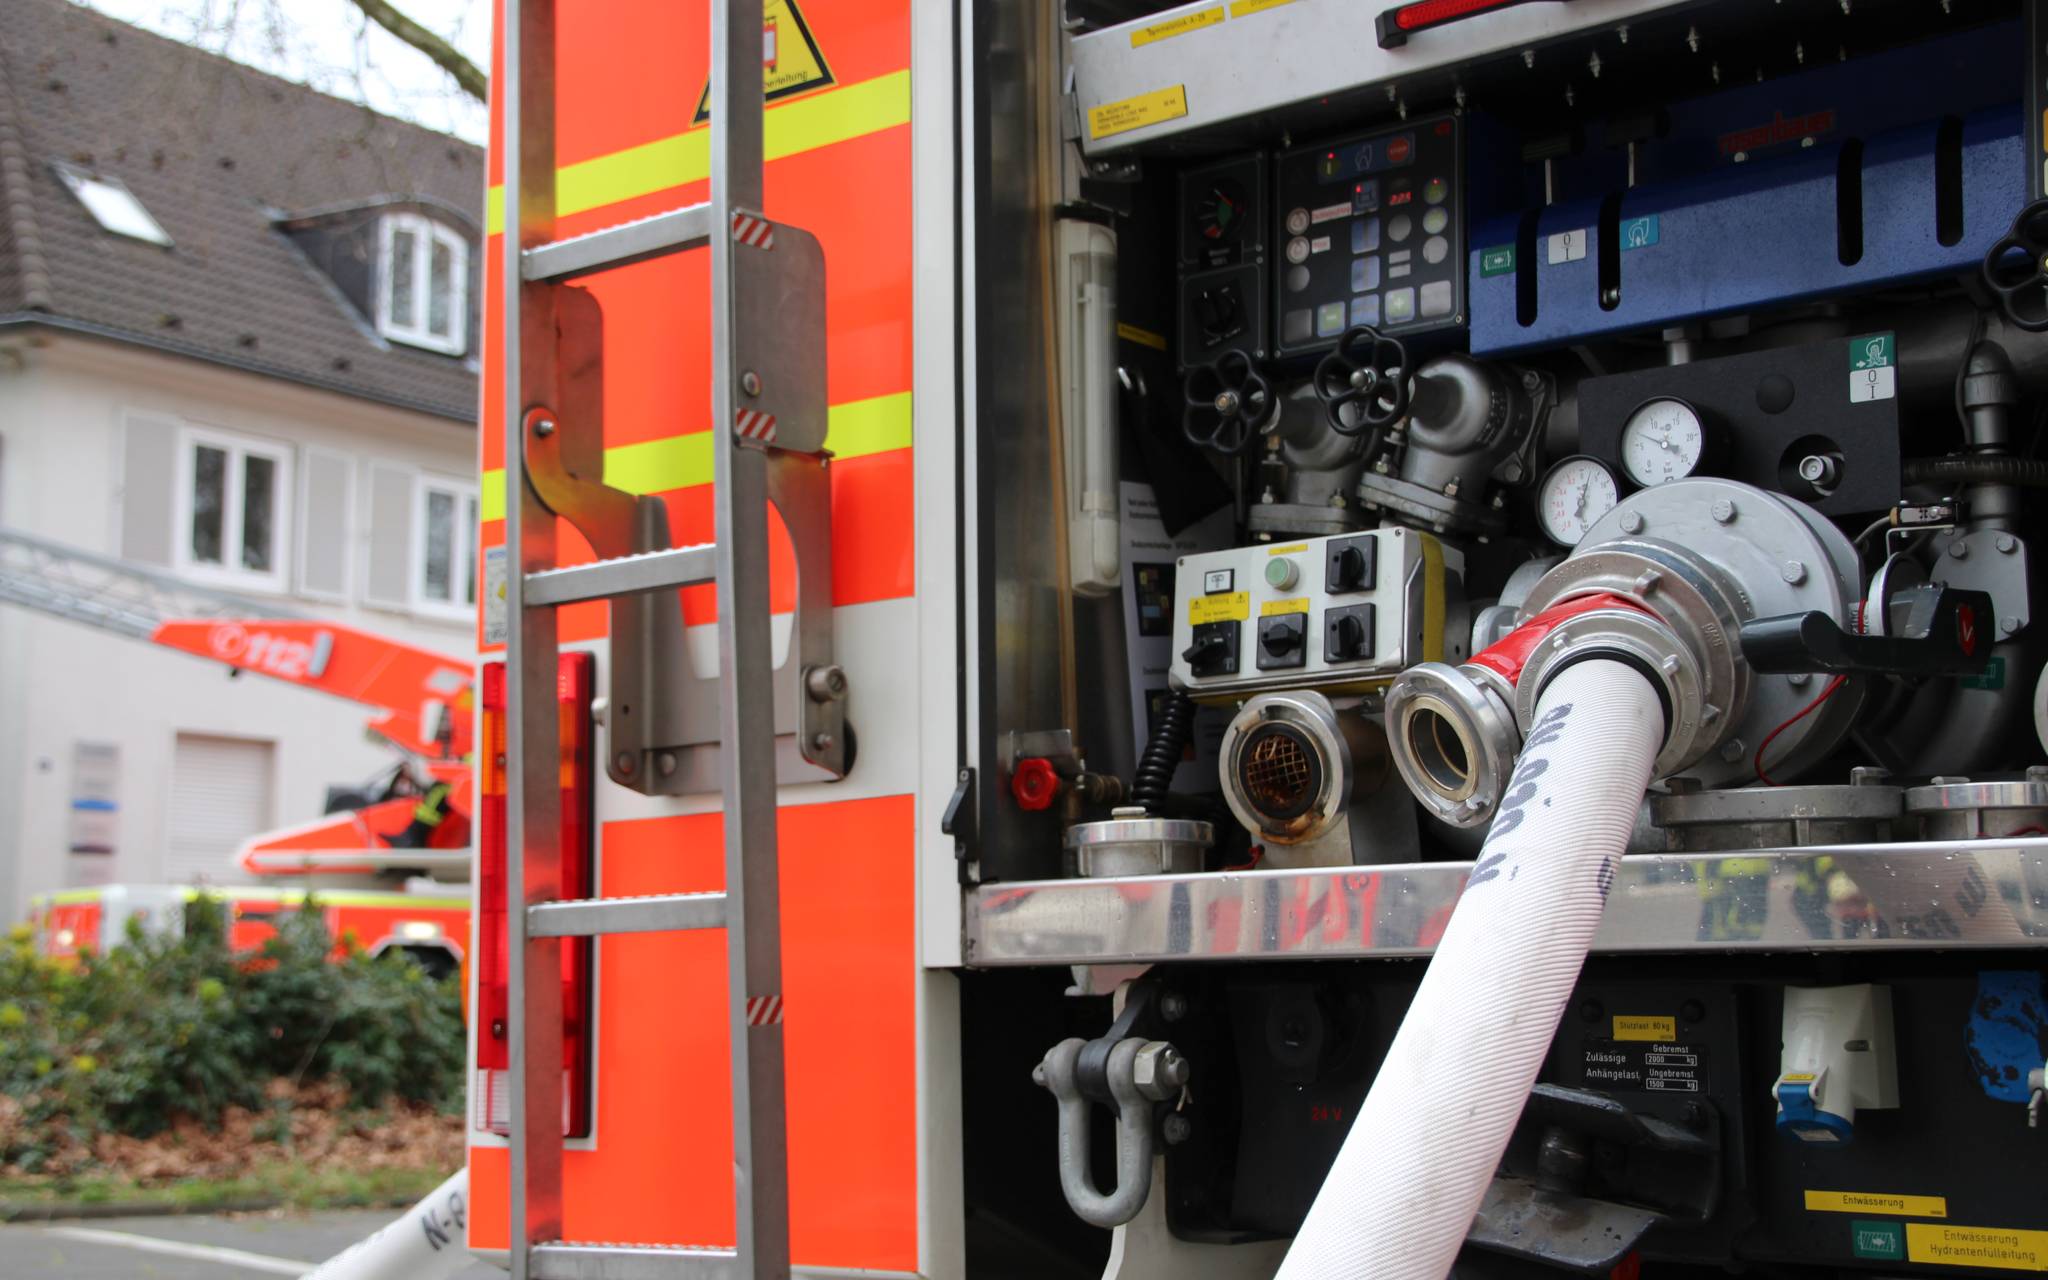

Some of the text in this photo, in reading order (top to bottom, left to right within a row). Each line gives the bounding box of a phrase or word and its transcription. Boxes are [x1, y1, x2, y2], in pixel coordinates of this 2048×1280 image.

[1718, 110, 1835, 154] rosenbauer
[245, 631, 313, 678] 112
[1652, 1044, 1689, 1053] Gebremst
[1585, 1051, 1626, 1065] Zulässige
[1648, 1055, 1695, 1065] 2000 kg
[1586, 1068, 1639, 1081] Anhängelast
[1649, 1068, 1694, 1079] Ungebremst
[1649, 1080, 1695, 1090] 1500 kg
[1842, 1195, 1904, 1209] Entwässerung
[1943, 1230, 2018, 1247] Entwässerung
